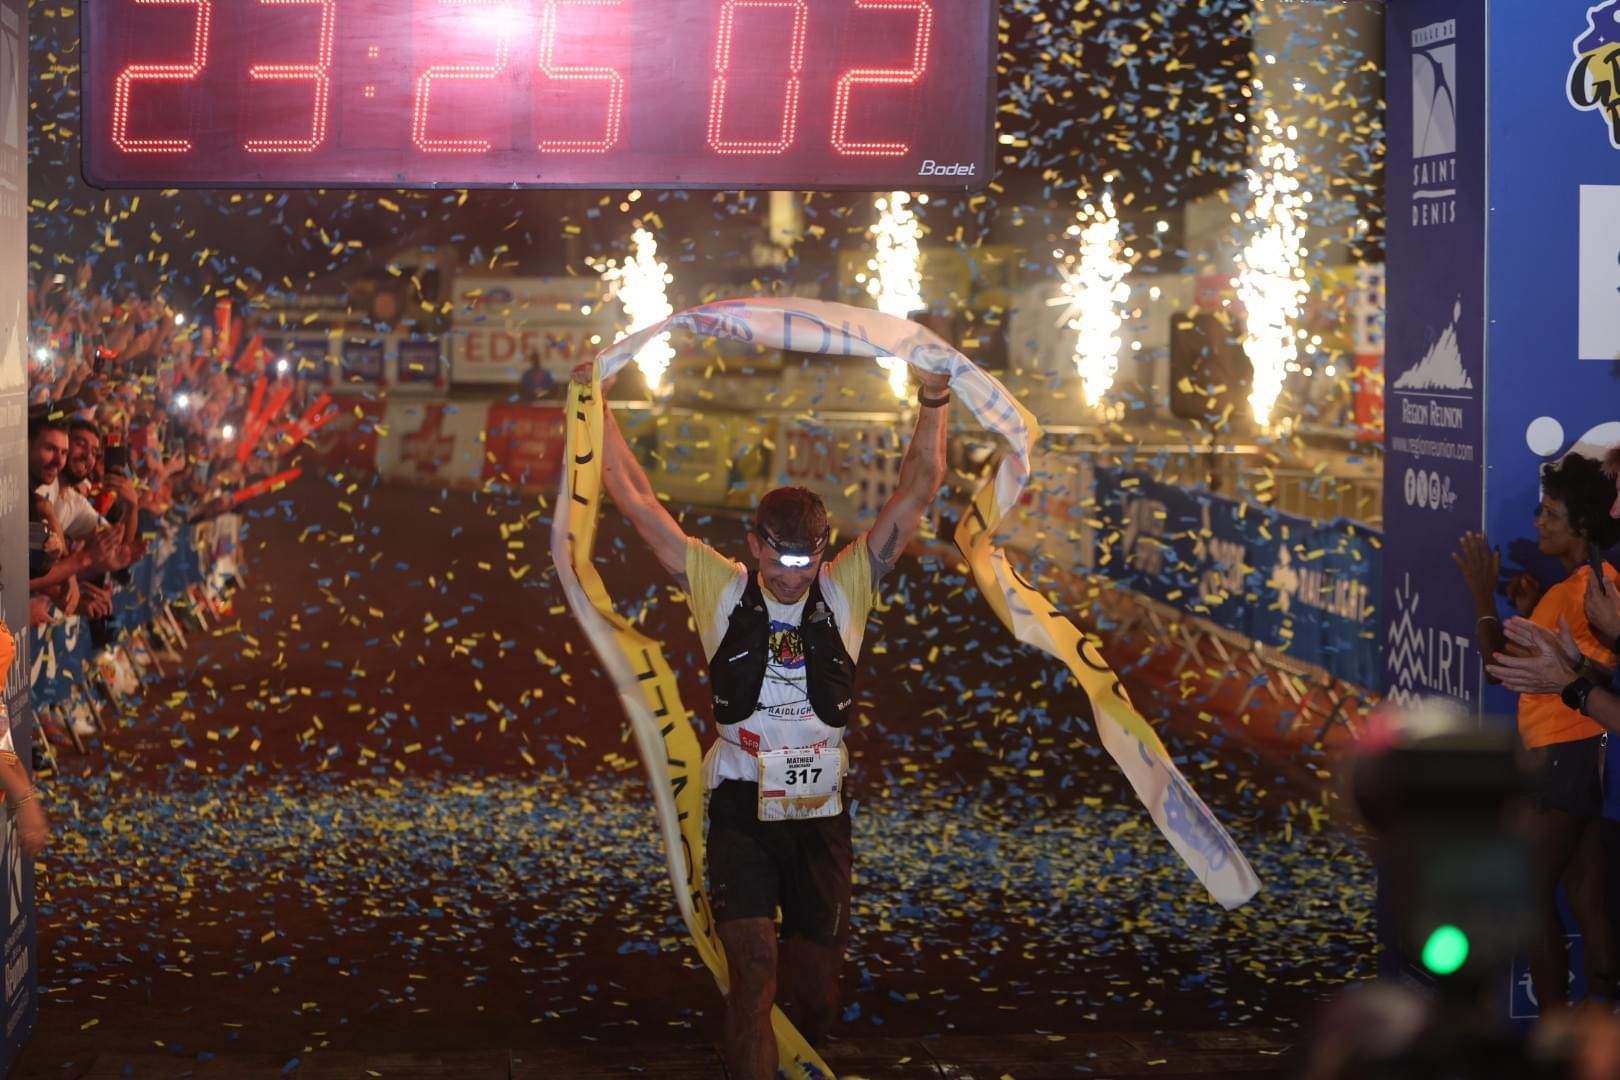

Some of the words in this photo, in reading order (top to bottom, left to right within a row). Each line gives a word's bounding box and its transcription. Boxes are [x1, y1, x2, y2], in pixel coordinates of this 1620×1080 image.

[917, 159, 976, 176] Bodet
[1413, 159, 1456, 186] SAINT
[1412, 200, 1456, 226] DENIS
[1392, 435, 1474, 461] www.regionreunion.com
[768, 706, 812, 716] RAIDLIGH
[786, 756, 814, 765] MATHIEU
[785, 767, 823, 785] 317
